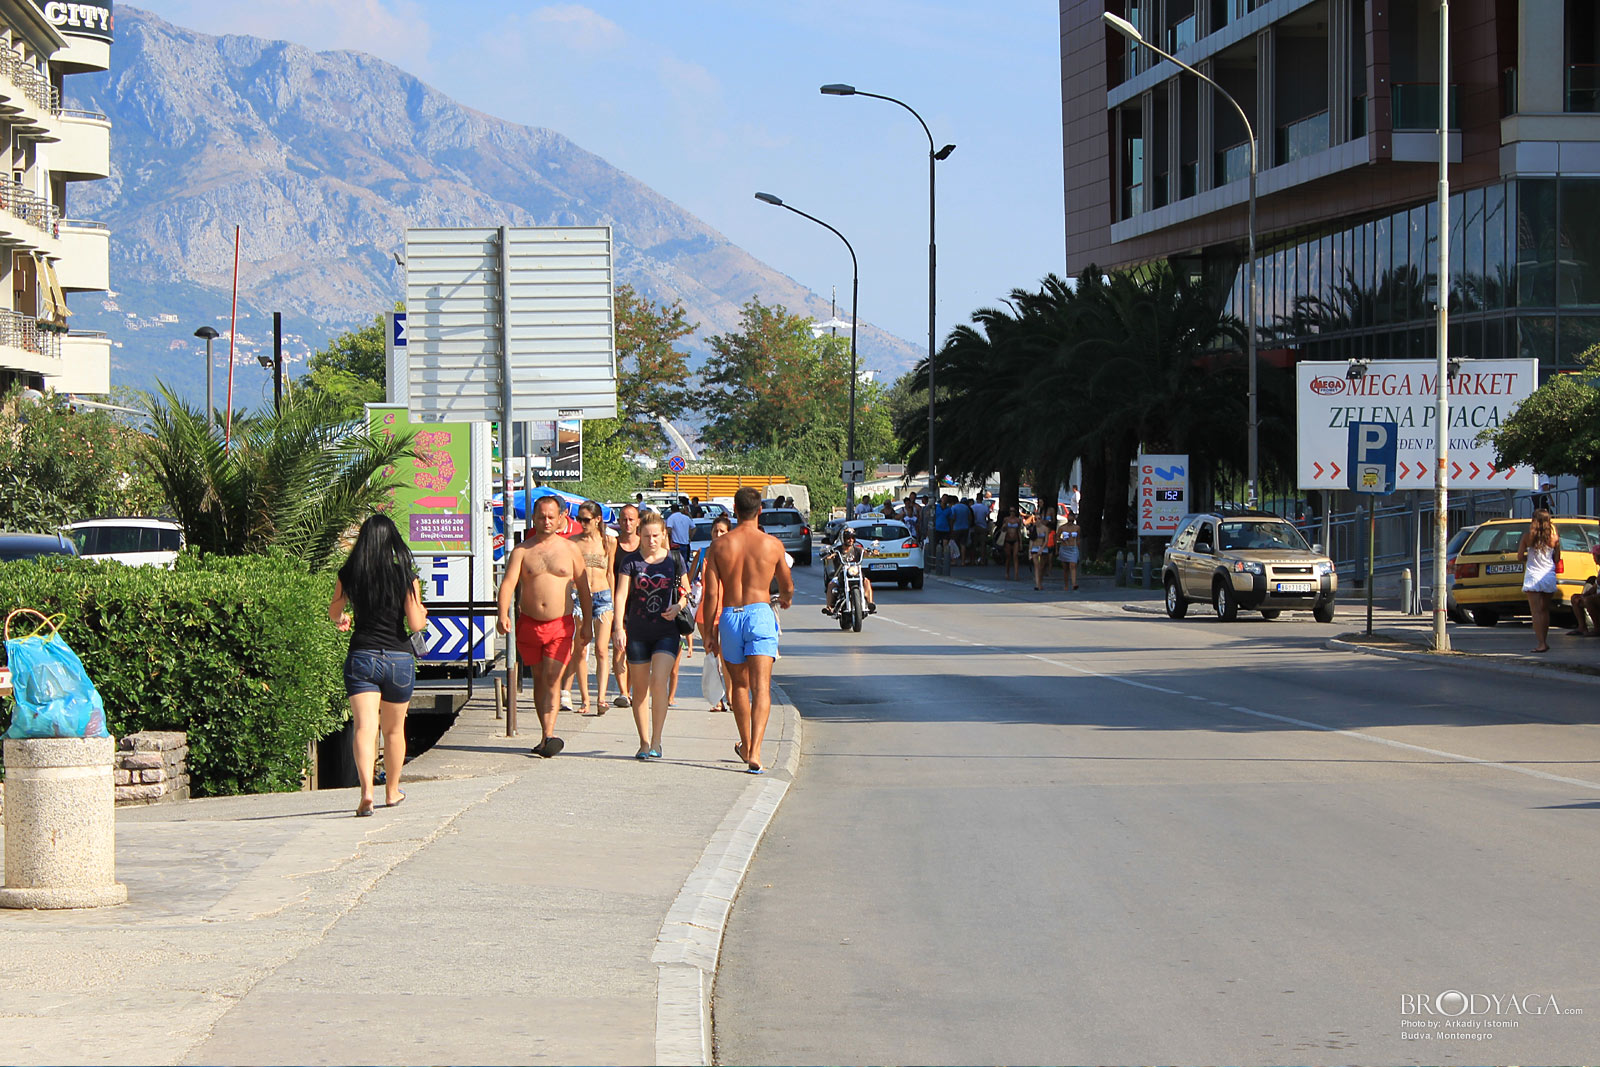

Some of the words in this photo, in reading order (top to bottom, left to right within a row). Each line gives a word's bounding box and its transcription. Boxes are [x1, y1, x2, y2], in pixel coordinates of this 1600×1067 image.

[44, 1, 109, 31] CITY
[1346, 373, 1413, 396] MEGA
[1421, 405, 1500, 431] PJACA
[1357, 424, 1388, 462] P
[412, 430, 456, 492] 5
[1142, 465, 1154, 530] GARAŽA
[1164, 491, 1178, 500] 152
[635, 576, 672, 589] LOVE
